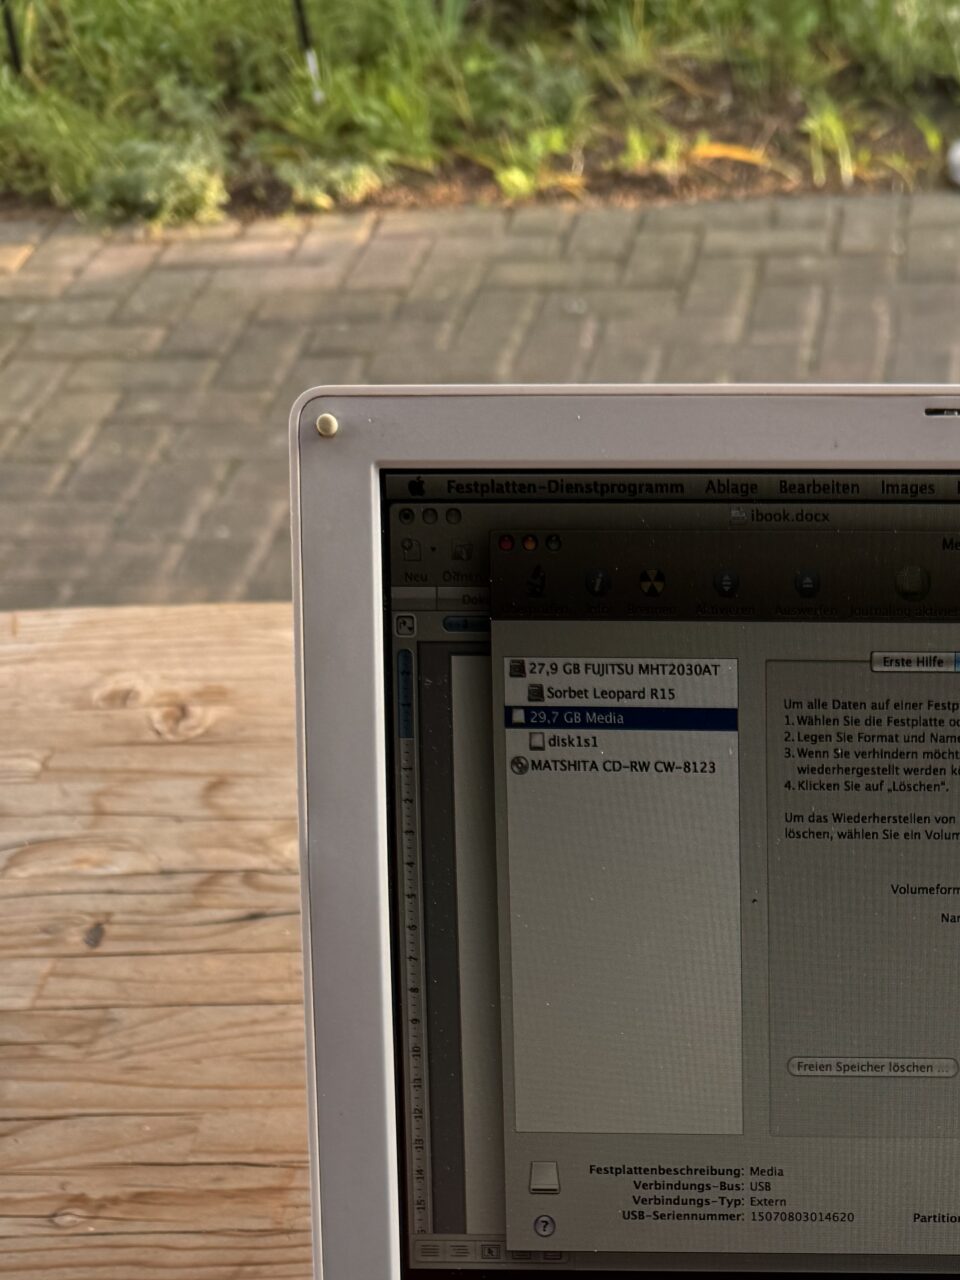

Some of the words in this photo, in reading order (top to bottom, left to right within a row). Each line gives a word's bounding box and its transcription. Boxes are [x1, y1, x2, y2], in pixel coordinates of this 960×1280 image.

[446, 479, 685, 495] Festplatten-Dienstprogramm
[704, 479, 759, 495] Ablage
[778, 480, 860, 495] Bearbeiten
[880, 480, 936, 497] Images
[750, 510, 830, 524] ibook.docx
[882, 655, 911, 668] Erste
[916, 655, 944, 668] Hilfe
[528, 662, 560, 678] 27,9
[561, 662, 581, 677] GB
[583, 662, 636, 678] FUJITSU
[637, 663, 721, 677] MHT2030AT
[546, 685, 590, 701] Sorbet
[591, 685, 648, 704] Leopard
[650, 686, 676, 701] R15
[783, 700, 802, 710] Um
[807, 700, 828, 710] alle
[832, 700, 867, 710] Daten
[871, 699, 891, 711] auf
[893, 700, 923, 711] einer
[530, 711, 561, 726] 29,7
[563, 711, 583, 724] GB
[586, 711, 624, 724] Media
[784, 716, 795, 727] 1.
[796, 715, 840, 727] Wählen
[843, 716, 861, 727] Sie
[864, 716, 883, 727] die
[887, 716, 945, 729] Festplatte
[547, 733, 599, 748] disk1s1
[783, 733, 795, 743] 2.
[797, 732, 832, 745] Legen
[836, 732, 854, 743] Sie
[857, 732, 899, 743] Format
[903, 733, 926, 743] und
[530, 760, 599, 774] MATSHITA
[602, 760, 651, 774] CD-RW
[653, 760, 717, 775] CW-8123
[784, 781, 796, 791] 4.
[797, 781, 841, 792] Klicken
[844, 781, 861, 792] Sie
[865, 781, 884, 792] auf
[797, 1061, 833, 1073] Freien
[836, 1061, 886, 1077] Speicher
[889, 1061, 934, 1074] löschen
[589, 1164, 745, 1179] Festplattenbeschreibung:
[750, 1166, 784, 1177] Media
[633, 1180, 745, 1194] Verbindungs-Bus:
[750, 1181, 772, 1192] USB
[632, 1195, 745, 1209] Verbindungs-Typ:
[750, 1196, 787, 1207] Extern
[621, 1210, 745, 1222] USB-Seriennummer:
[751, 1211, 855, 1223] 15070803014620
